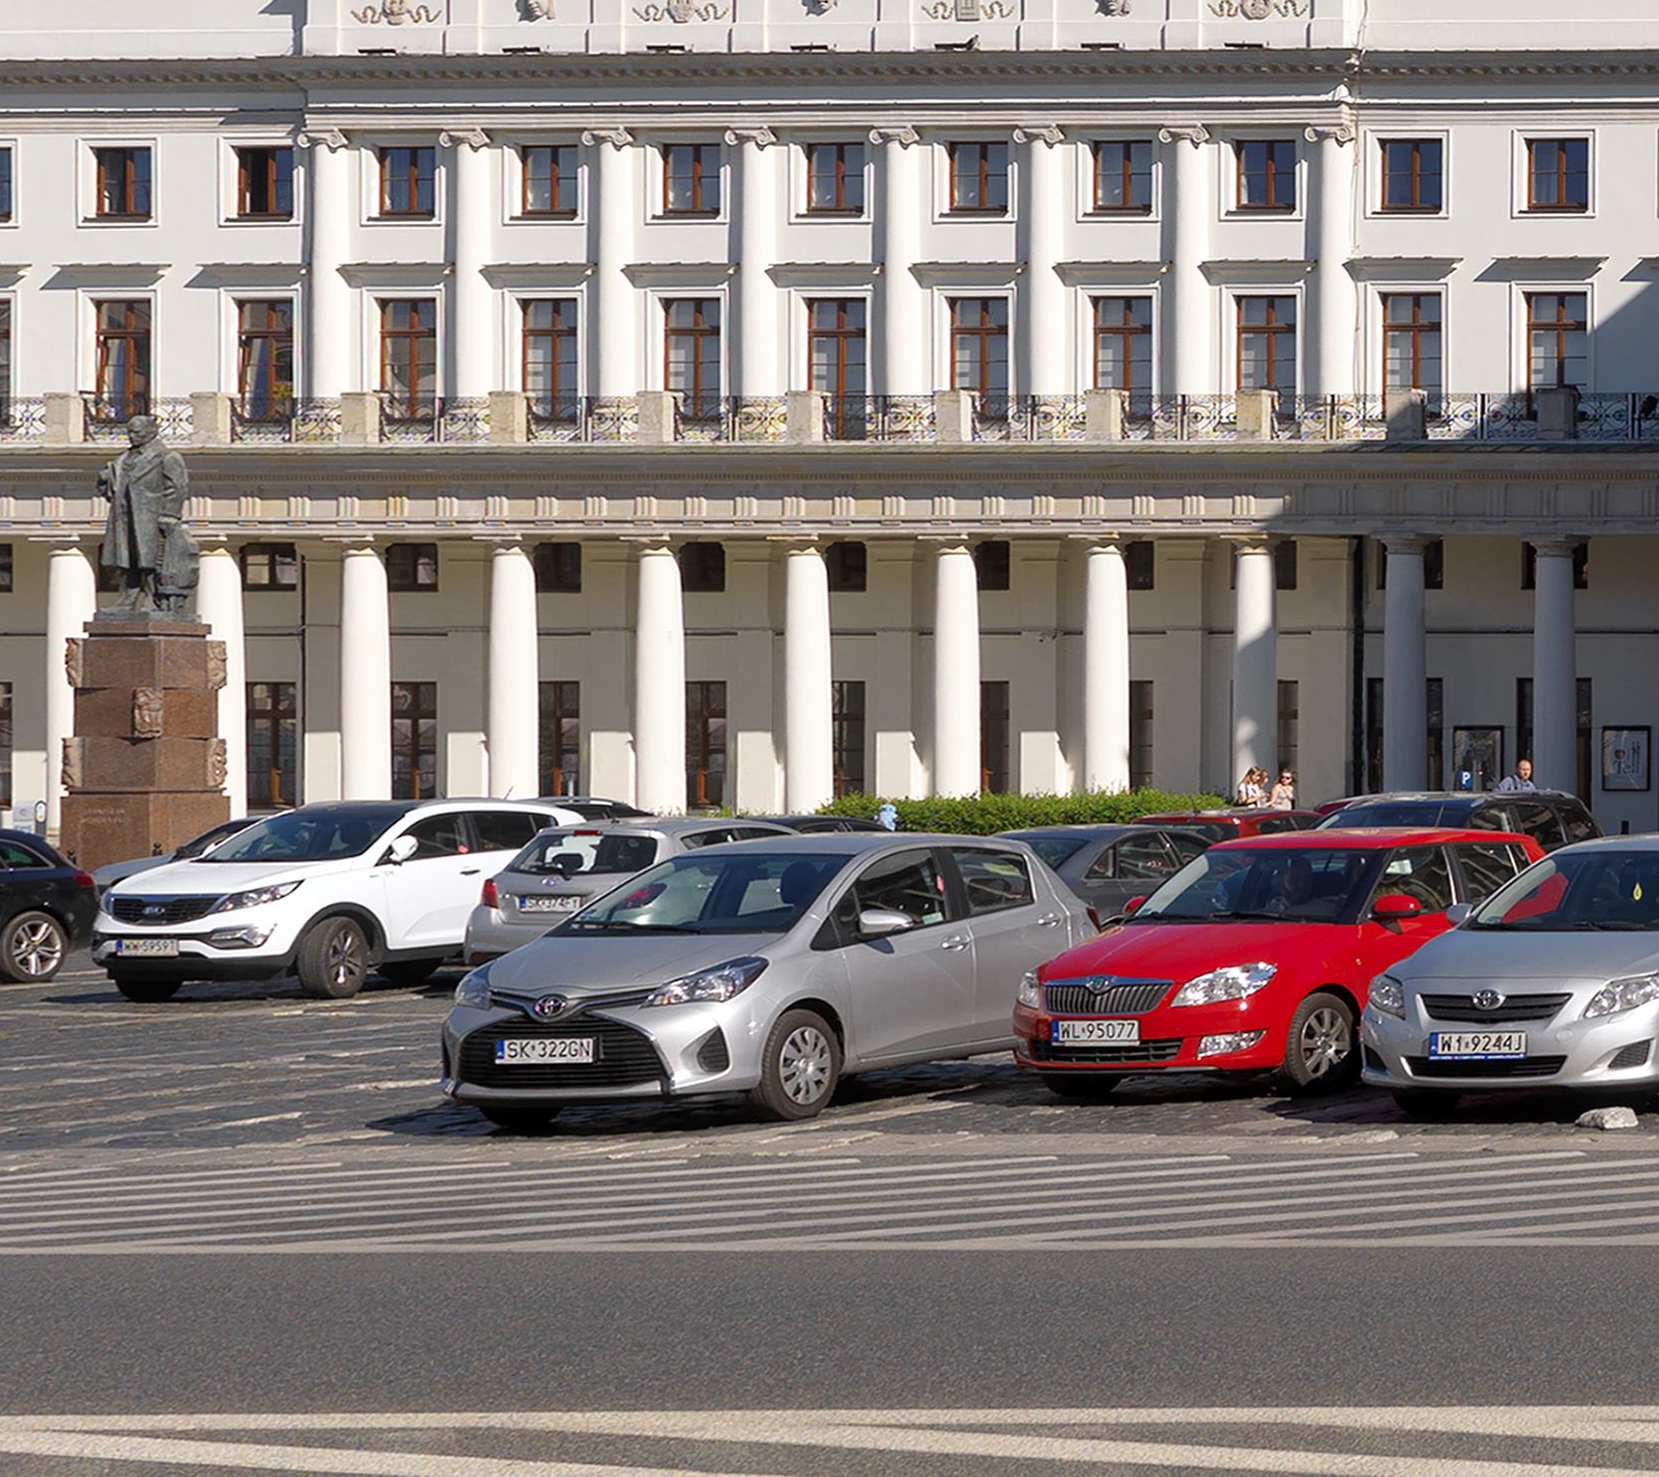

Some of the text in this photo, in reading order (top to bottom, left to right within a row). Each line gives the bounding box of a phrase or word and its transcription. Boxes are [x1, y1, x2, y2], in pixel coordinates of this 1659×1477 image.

[1060, 1023, 1136, 1041] WL 95077
[1470, 1032, 1523, 1051] 9244J
[507, 1038, 591, 1058] SK 322GN
